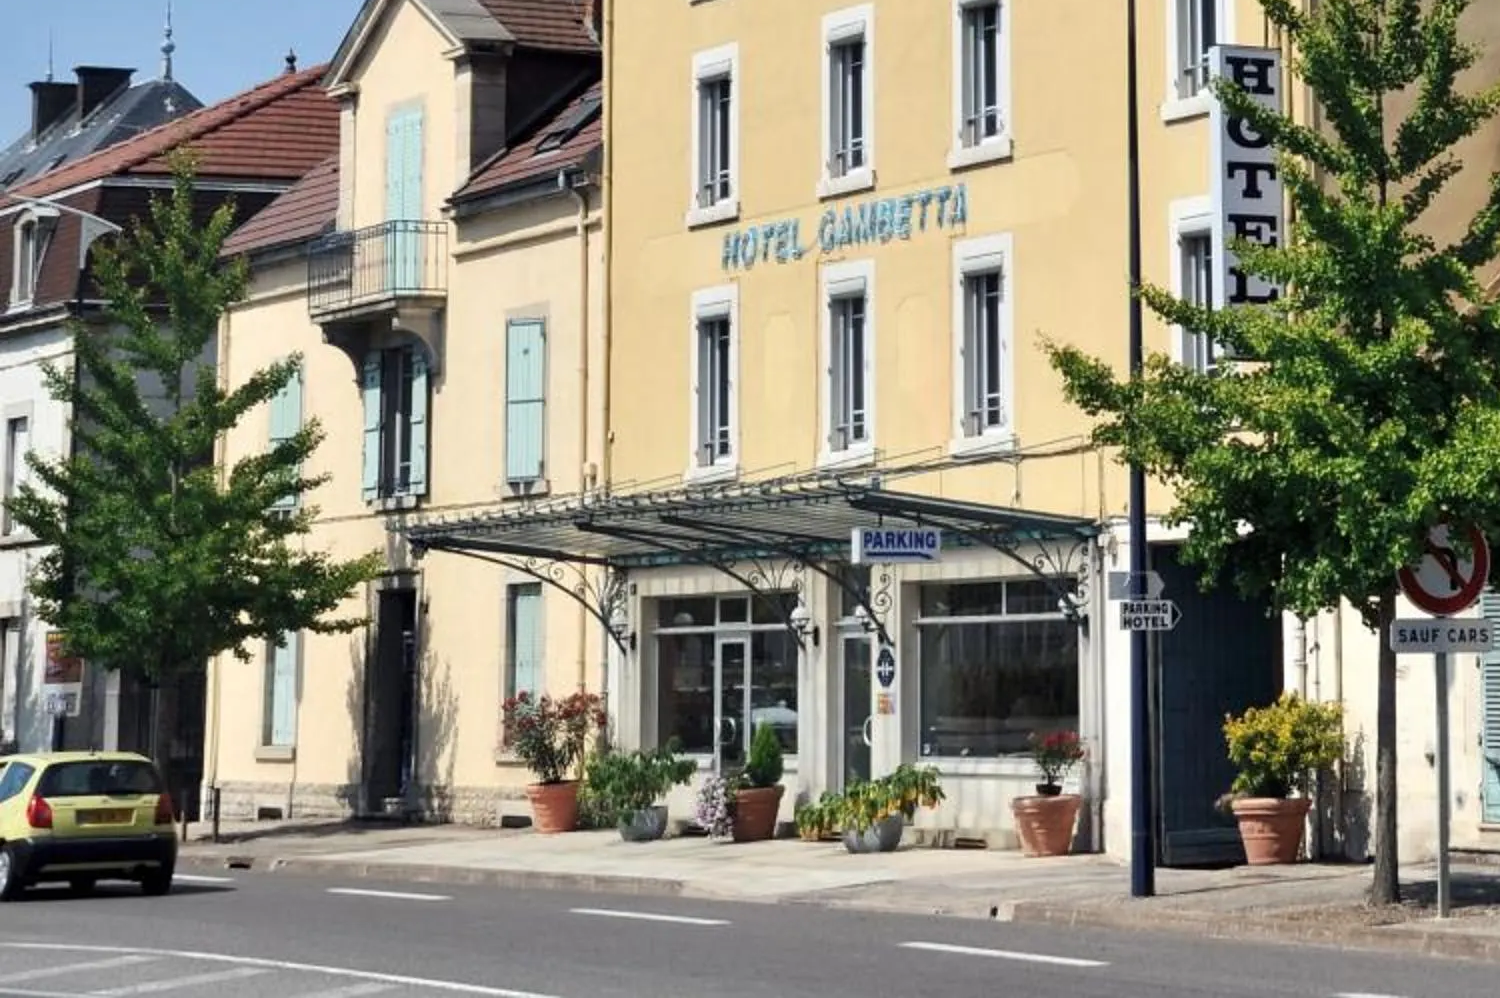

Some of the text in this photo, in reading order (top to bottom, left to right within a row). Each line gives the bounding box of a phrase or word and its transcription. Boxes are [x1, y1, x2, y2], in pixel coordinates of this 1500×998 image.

[721, 183, 969, 270] HOTEL GAMBETTA
[863, 530, 937, 550] PARKING
[1123, 602, 1169, 614] PARKING
[1123, 616, 1169, 629] HOTEL
[1397, 628, 1490, 644] SAUF CARS
